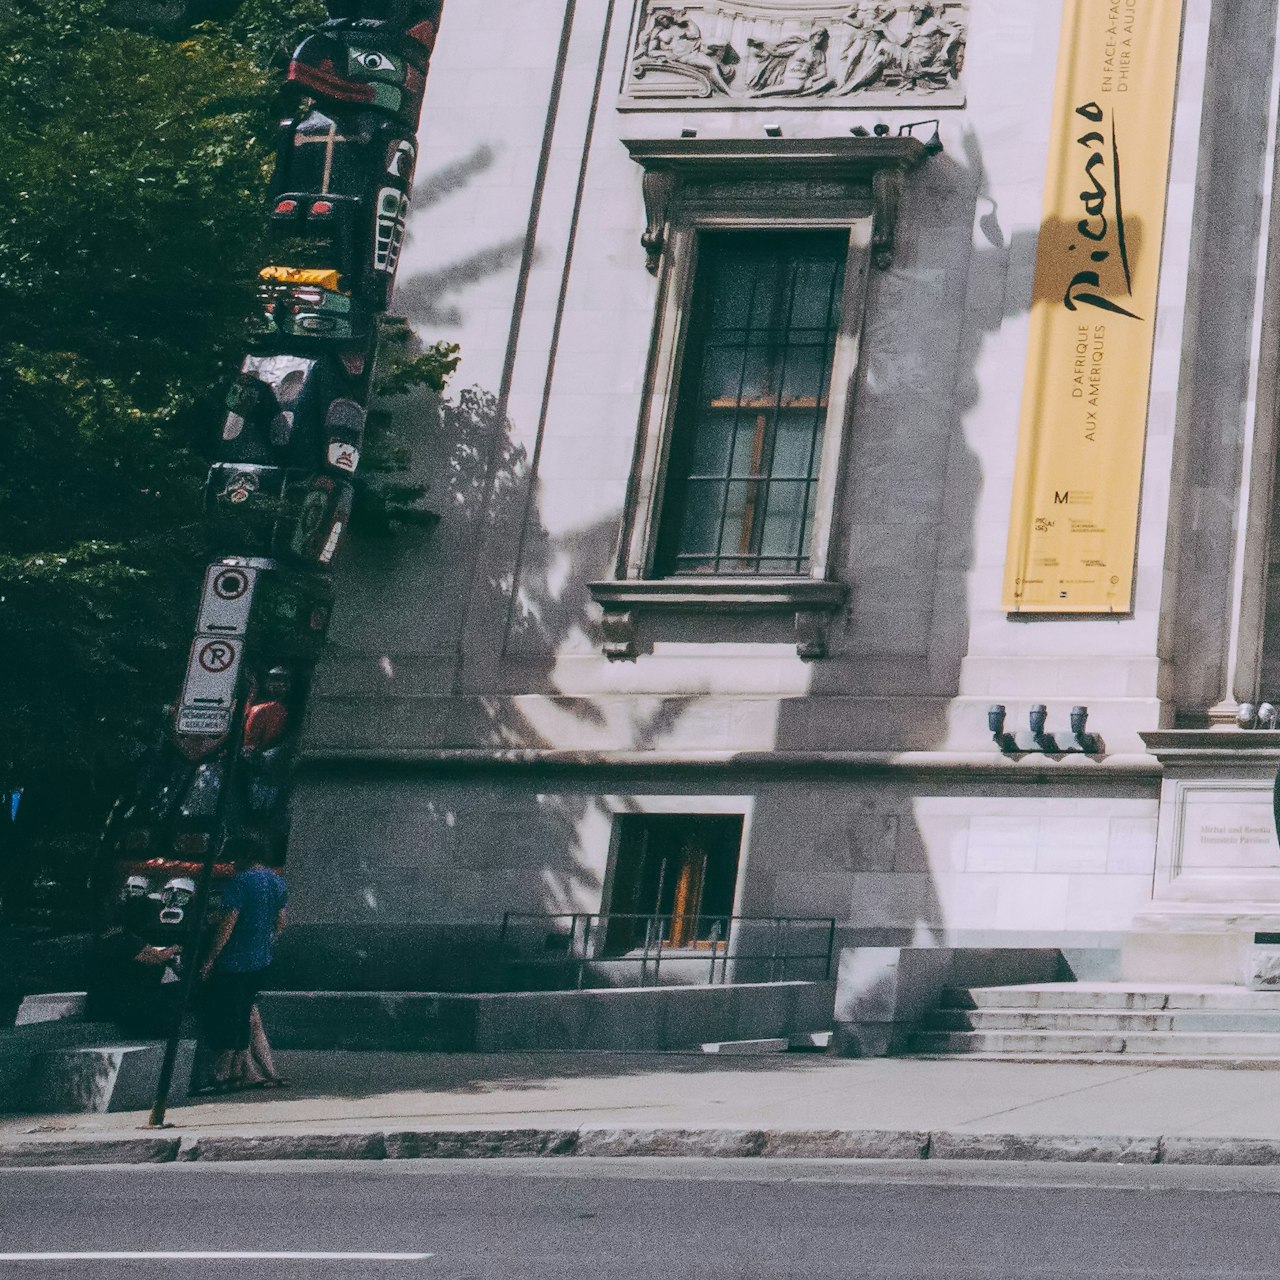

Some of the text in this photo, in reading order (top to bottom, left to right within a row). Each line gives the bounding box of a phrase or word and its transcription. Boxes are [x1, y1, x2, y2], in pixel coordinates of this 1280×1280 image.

[1101, 77, 1113, 93] EN
[1117, 51, 1131, 93] D'HIER
[1071, 325, 1089, 398] D'AFRIQUE
[1085, 325, 1106, 442] AUX AMÉRIQUES
[1054, 491, 1069, 504] M
